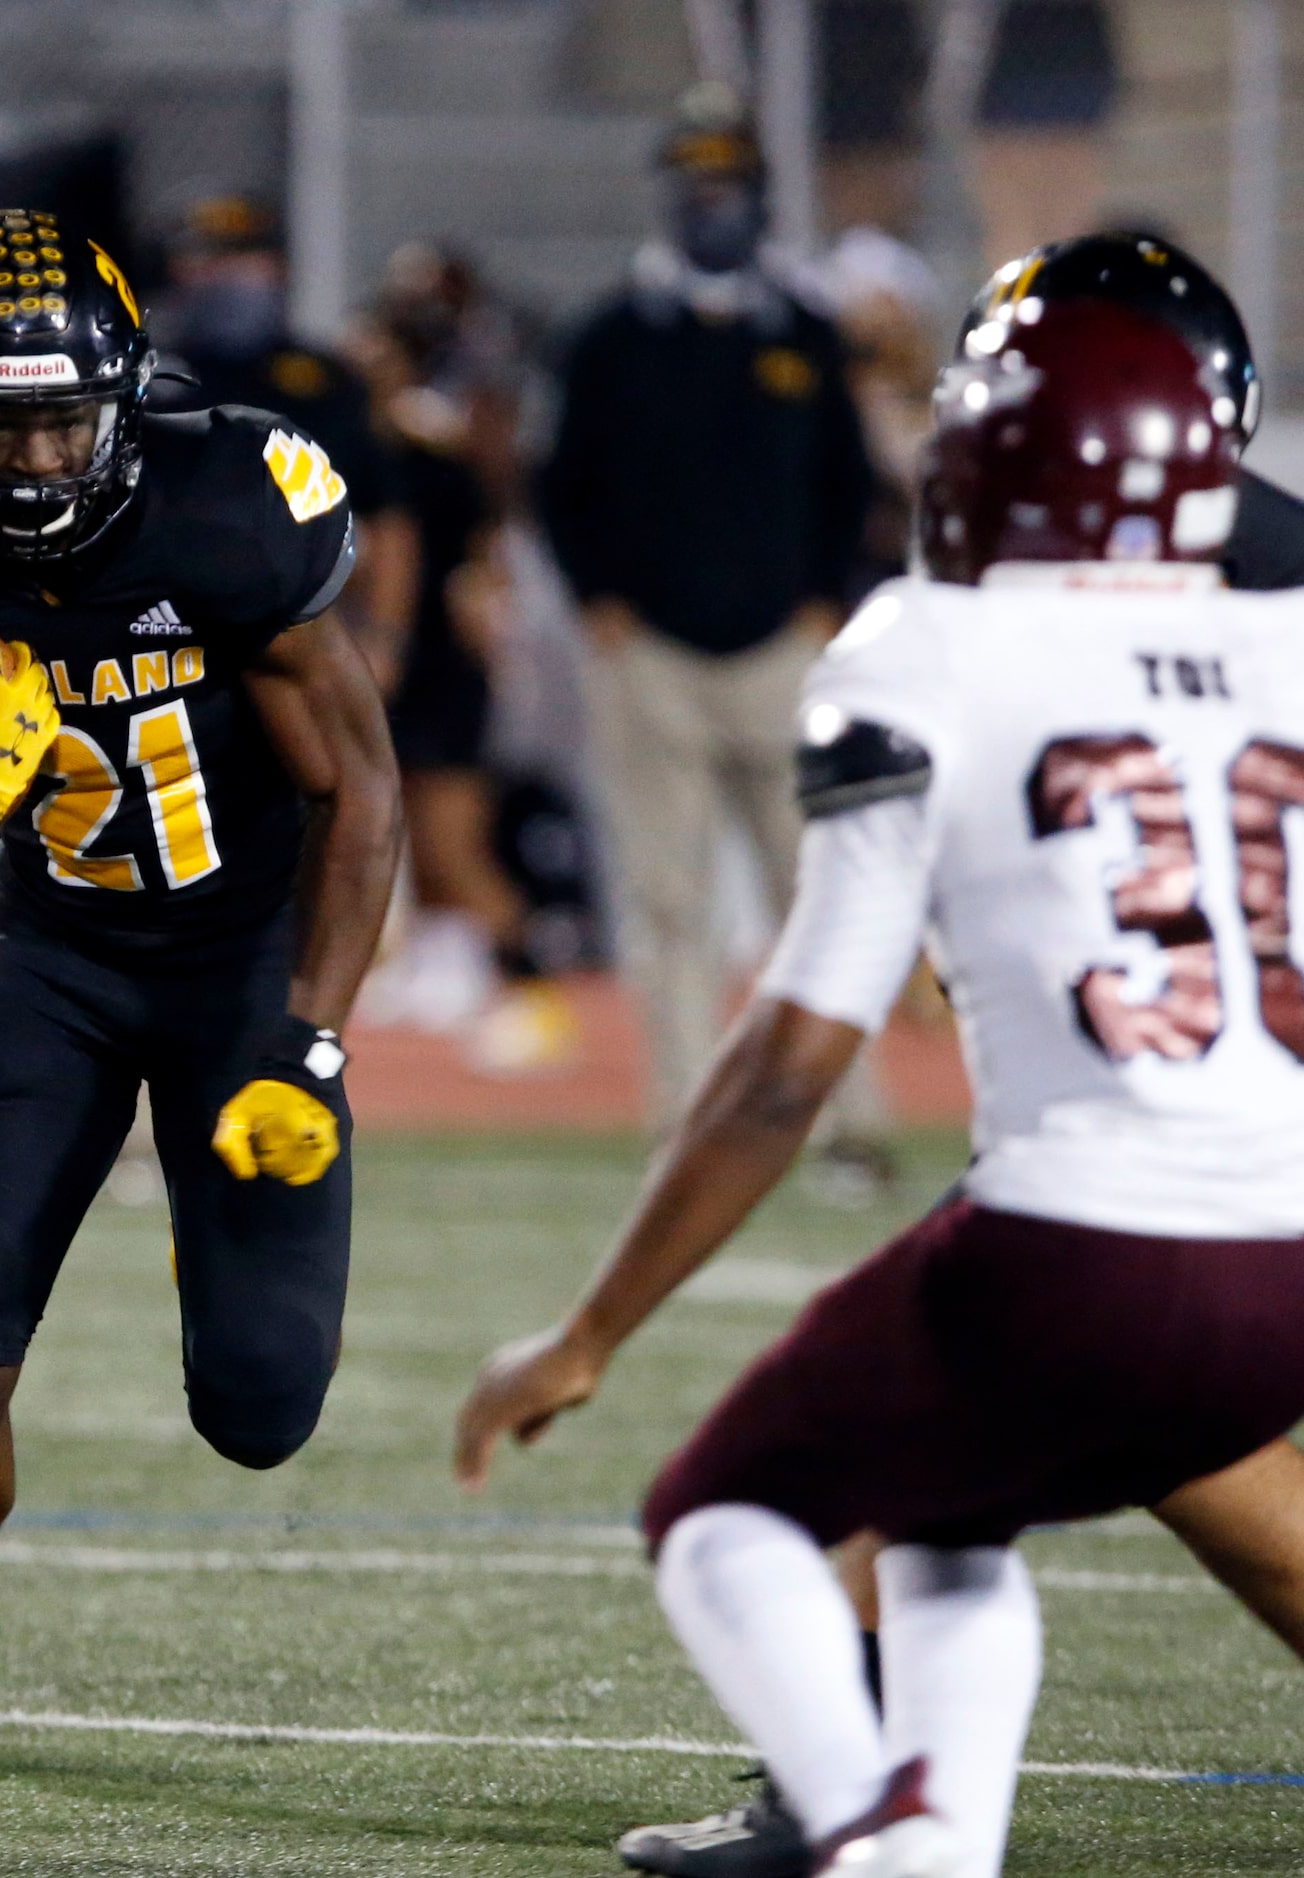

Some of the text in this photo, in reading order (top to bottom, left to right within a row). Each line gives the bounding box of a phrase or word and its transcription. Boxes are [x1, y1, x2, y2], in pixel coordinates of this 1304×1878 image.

[129, 621, 193, 636] adidas
[42, 647, 205, 706] LAND
[32, 698, 222, 891] 21
